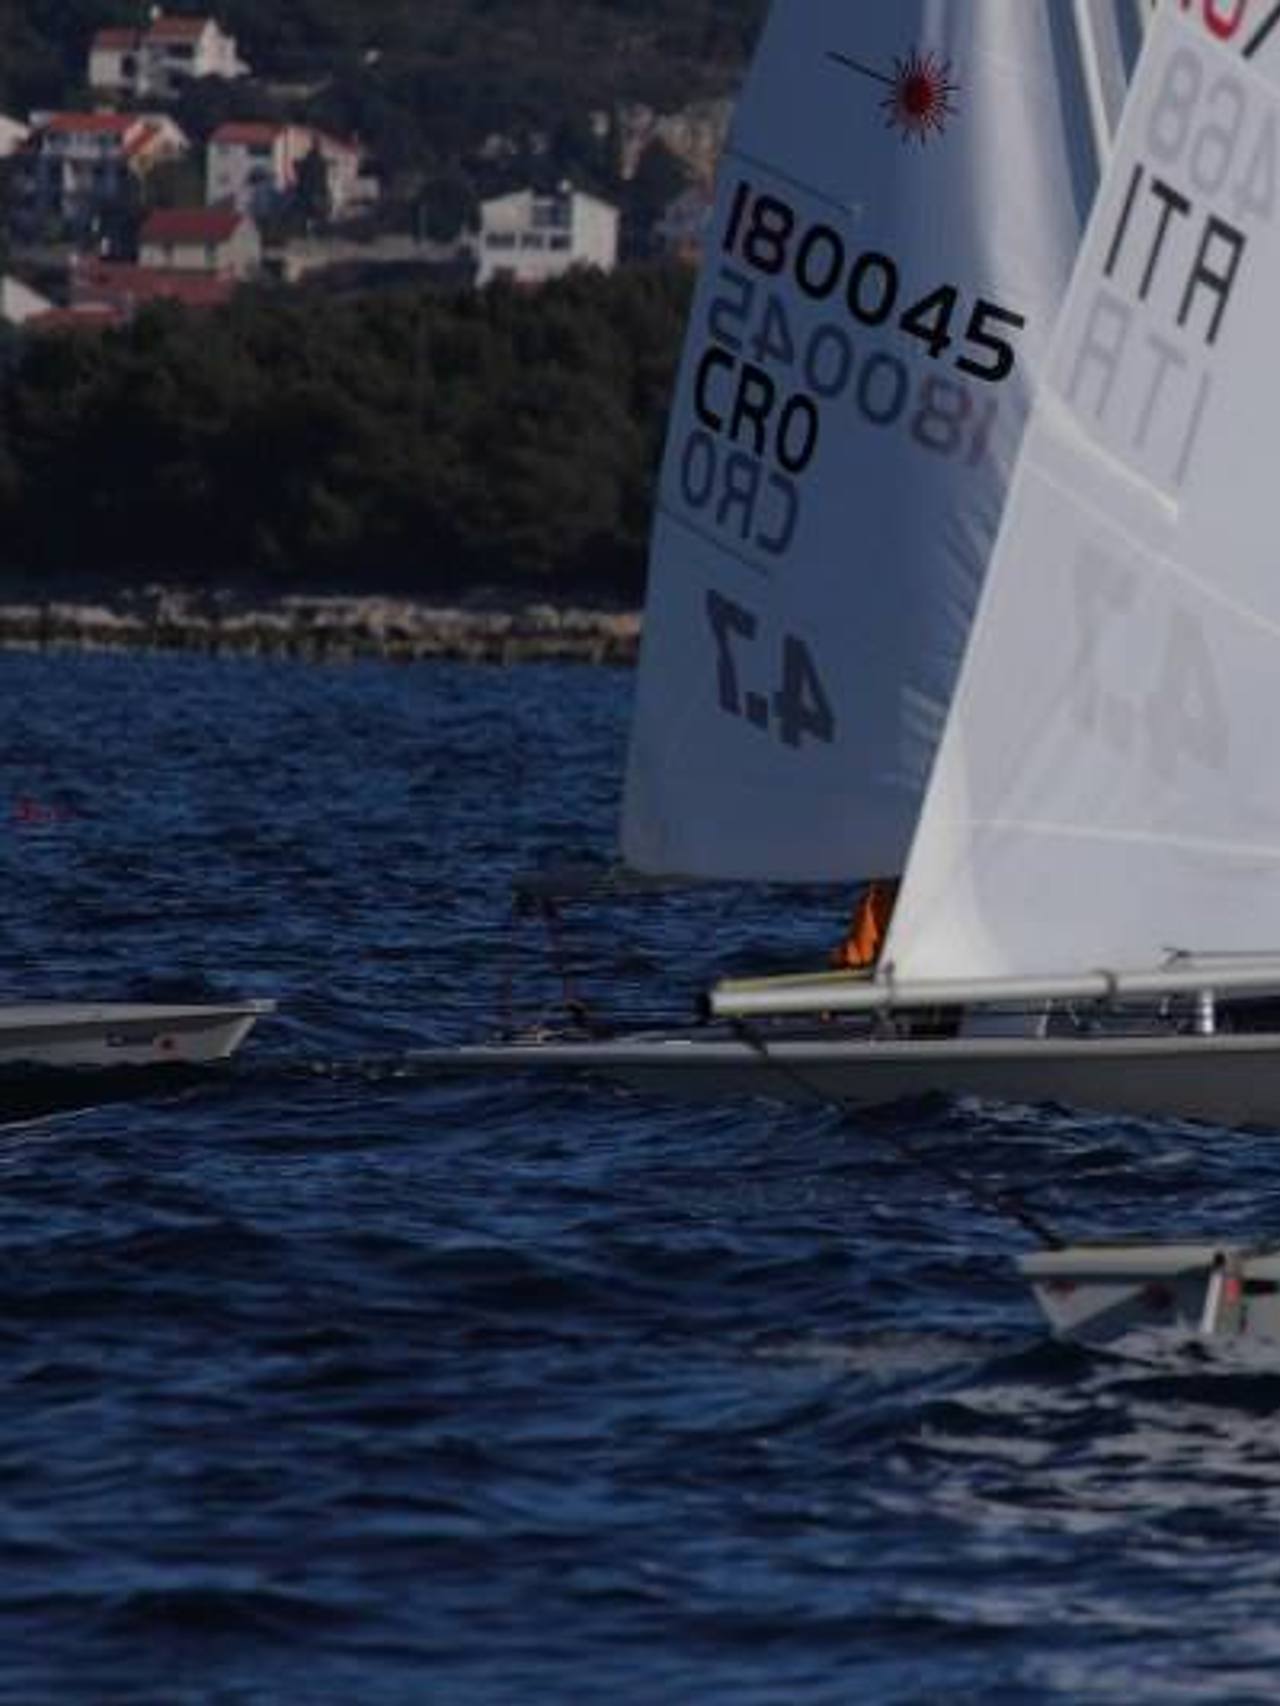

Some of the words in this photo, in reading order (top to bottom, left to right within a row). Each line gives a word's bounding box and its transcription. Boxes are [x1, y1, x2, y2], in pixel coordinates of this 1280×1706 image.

[722, 180, 1025, 382] 180045
[1104, 164, 1247, 346] ITA
[695, 347, 818, 474] CRO
